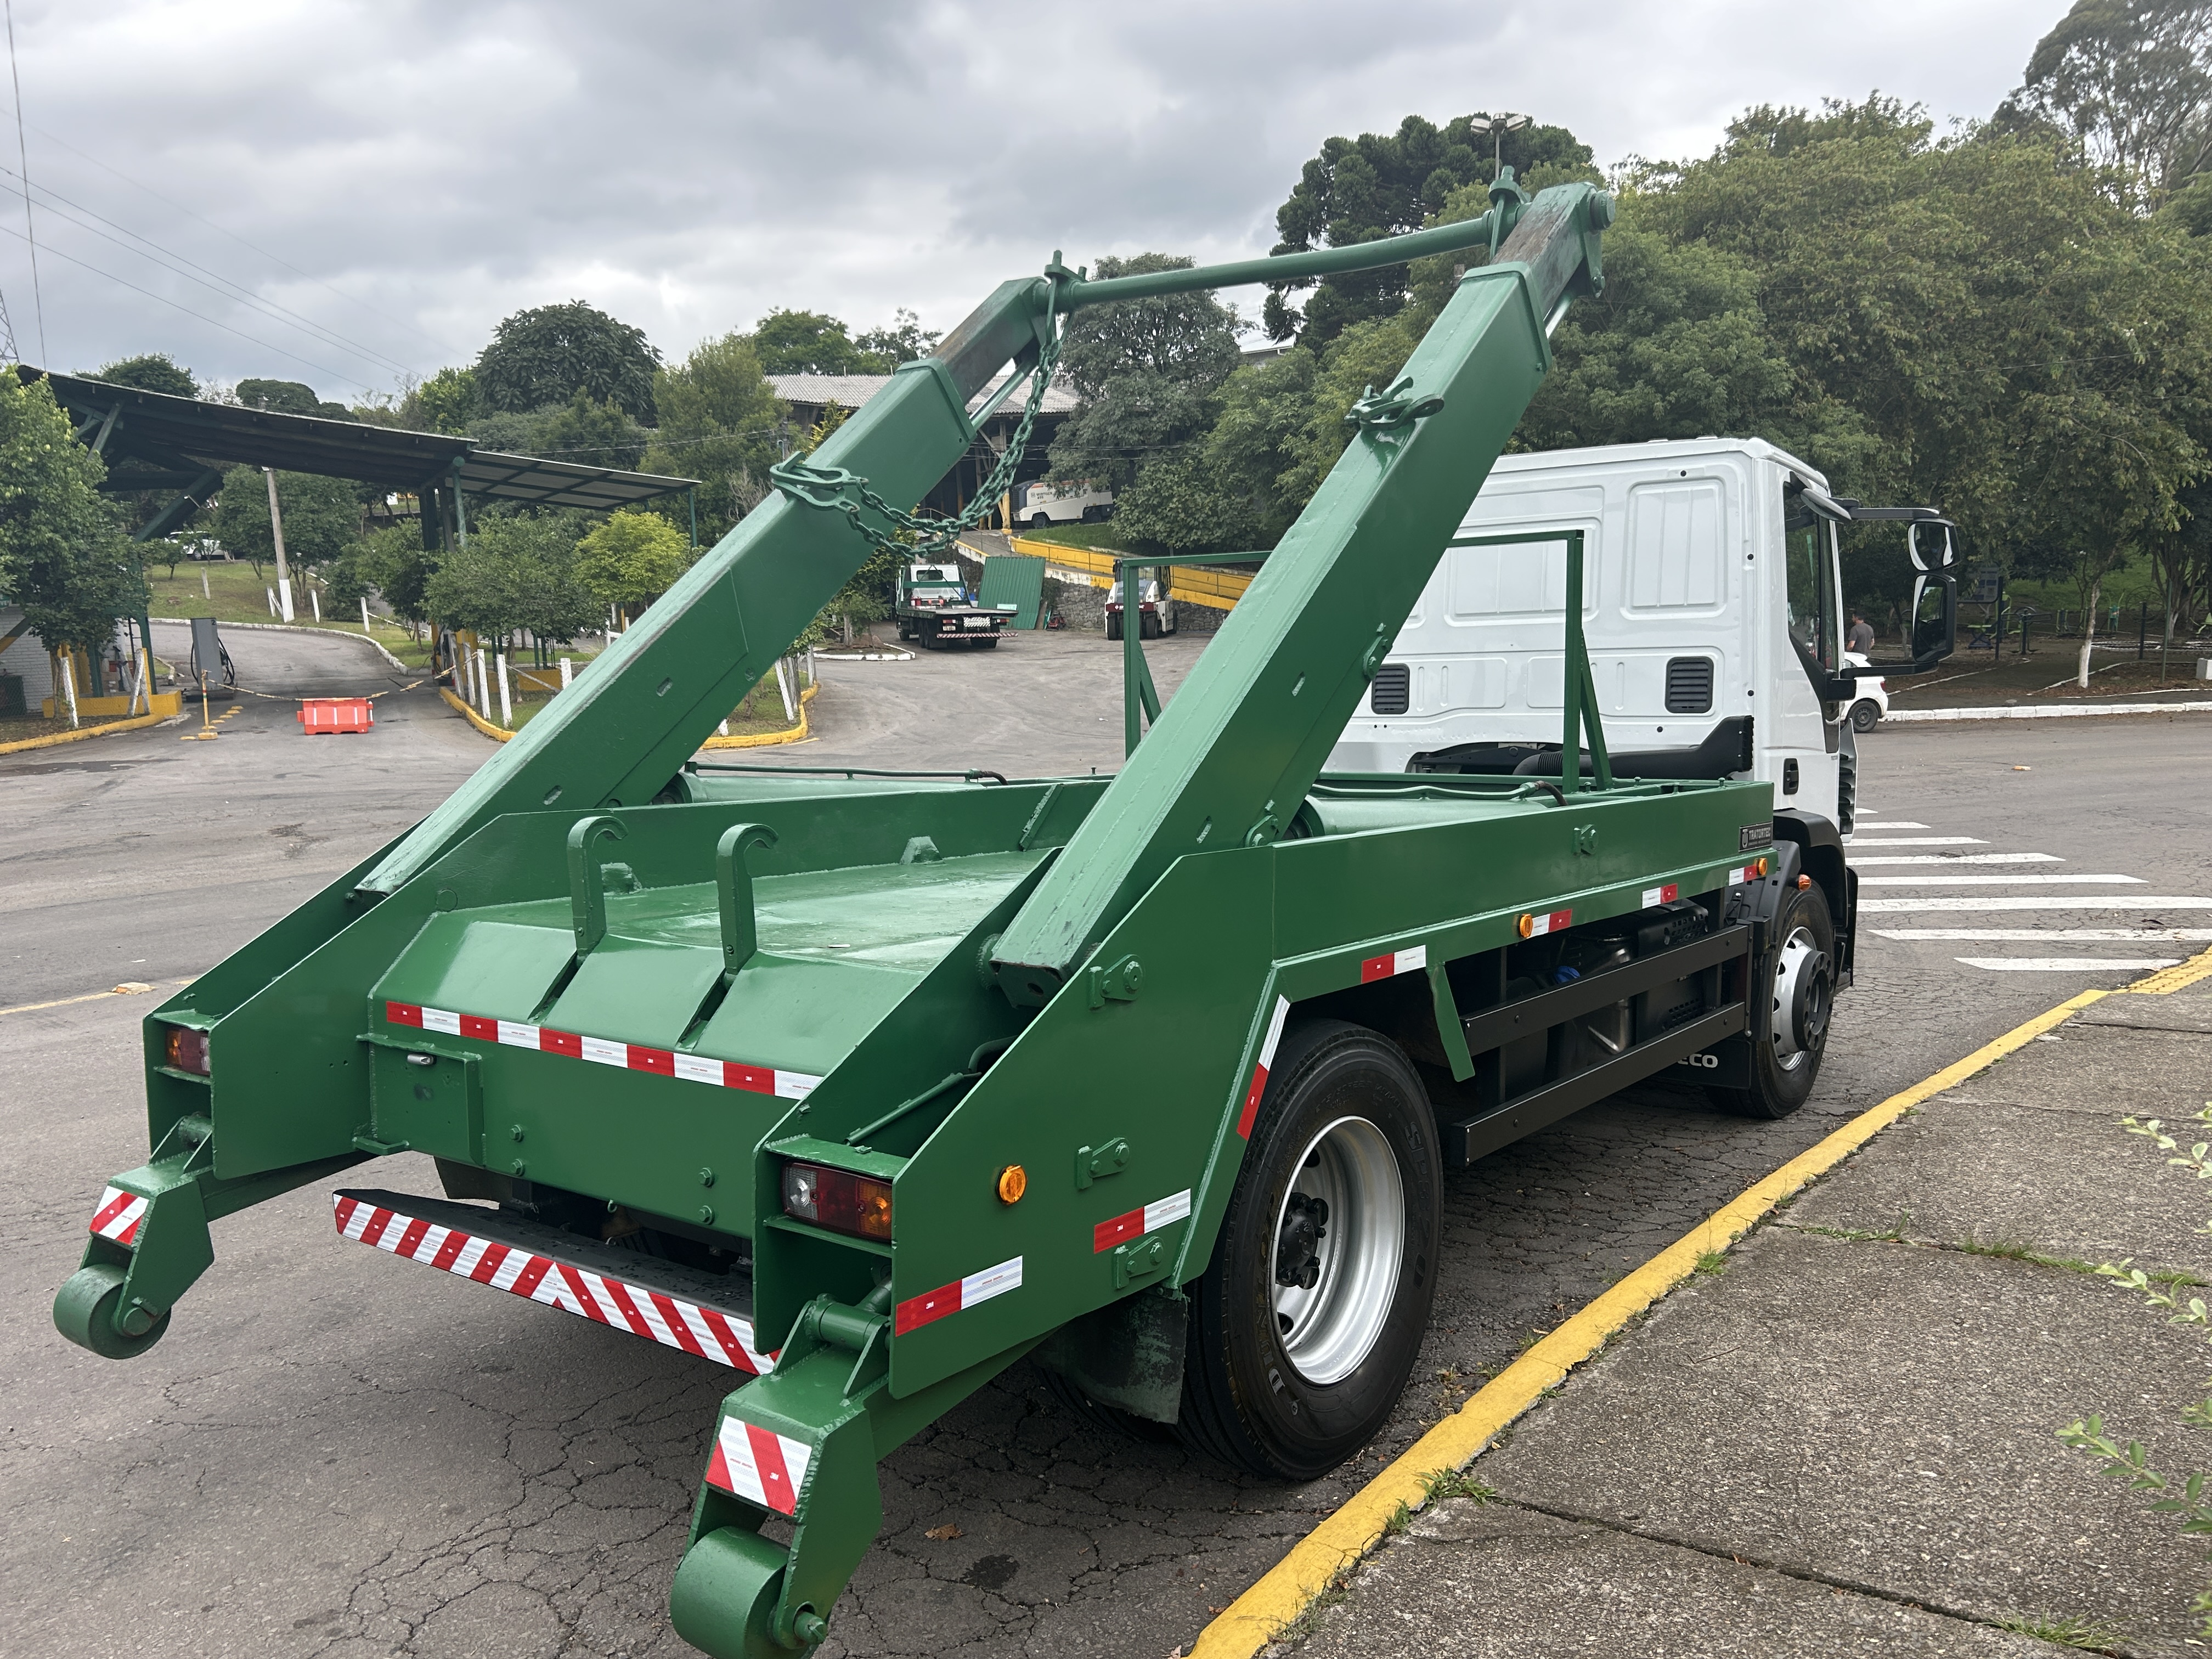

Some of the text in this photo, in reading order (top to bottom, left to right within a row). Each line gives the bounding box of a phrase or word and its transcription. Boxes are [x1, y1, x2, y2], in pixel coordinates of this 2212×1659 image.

[1256, 1191, 1285, 1397] DUNLOP
[926, 1301, 934, 1310] 3M
[770, 1472, 779, 1481] 3M
